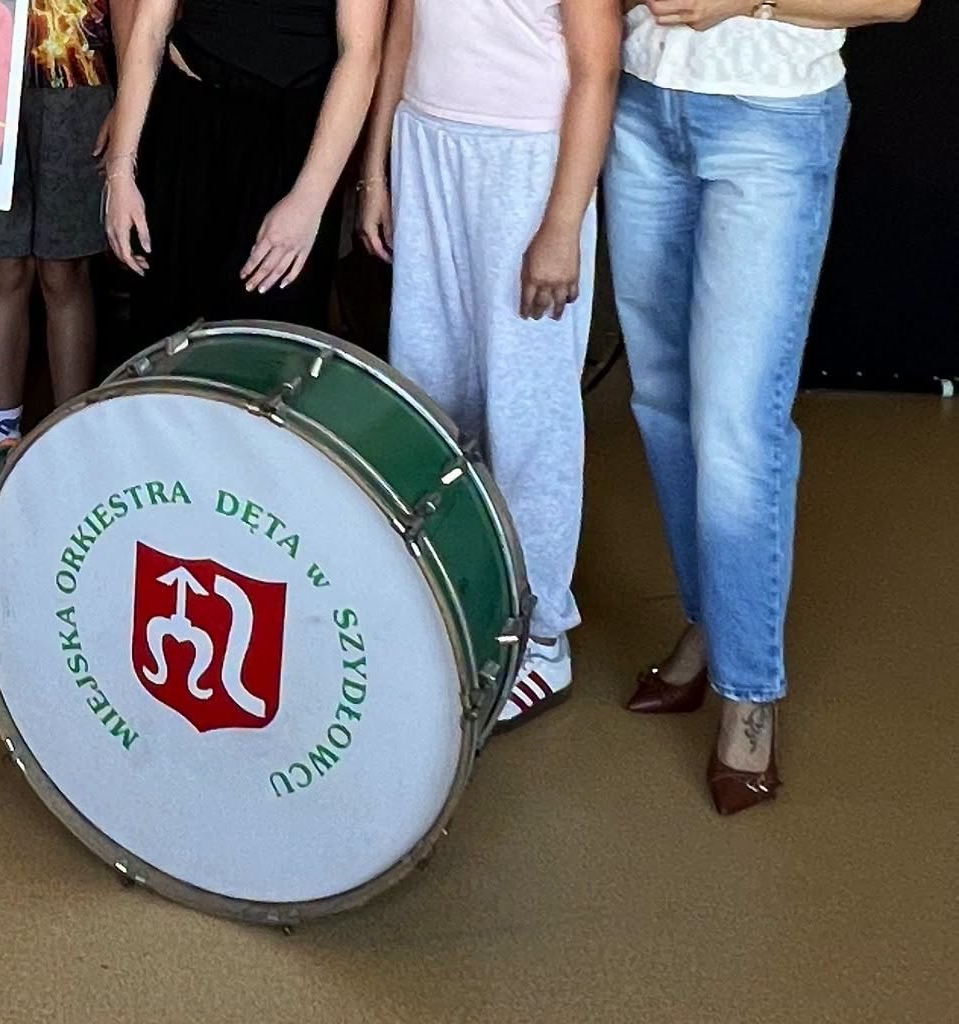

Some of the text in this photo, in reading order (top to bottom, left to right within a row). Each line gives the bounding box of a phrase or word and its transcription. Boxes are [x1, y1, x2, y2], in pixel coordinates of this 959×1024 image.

[55, 480, 191, 594] ORKIESTRA
[215, 489, 301, 560] DĘTA
[55, 605, 140, 751] MIEJSKA
[269, 608, 368, 797] SZYDŁOWCU
